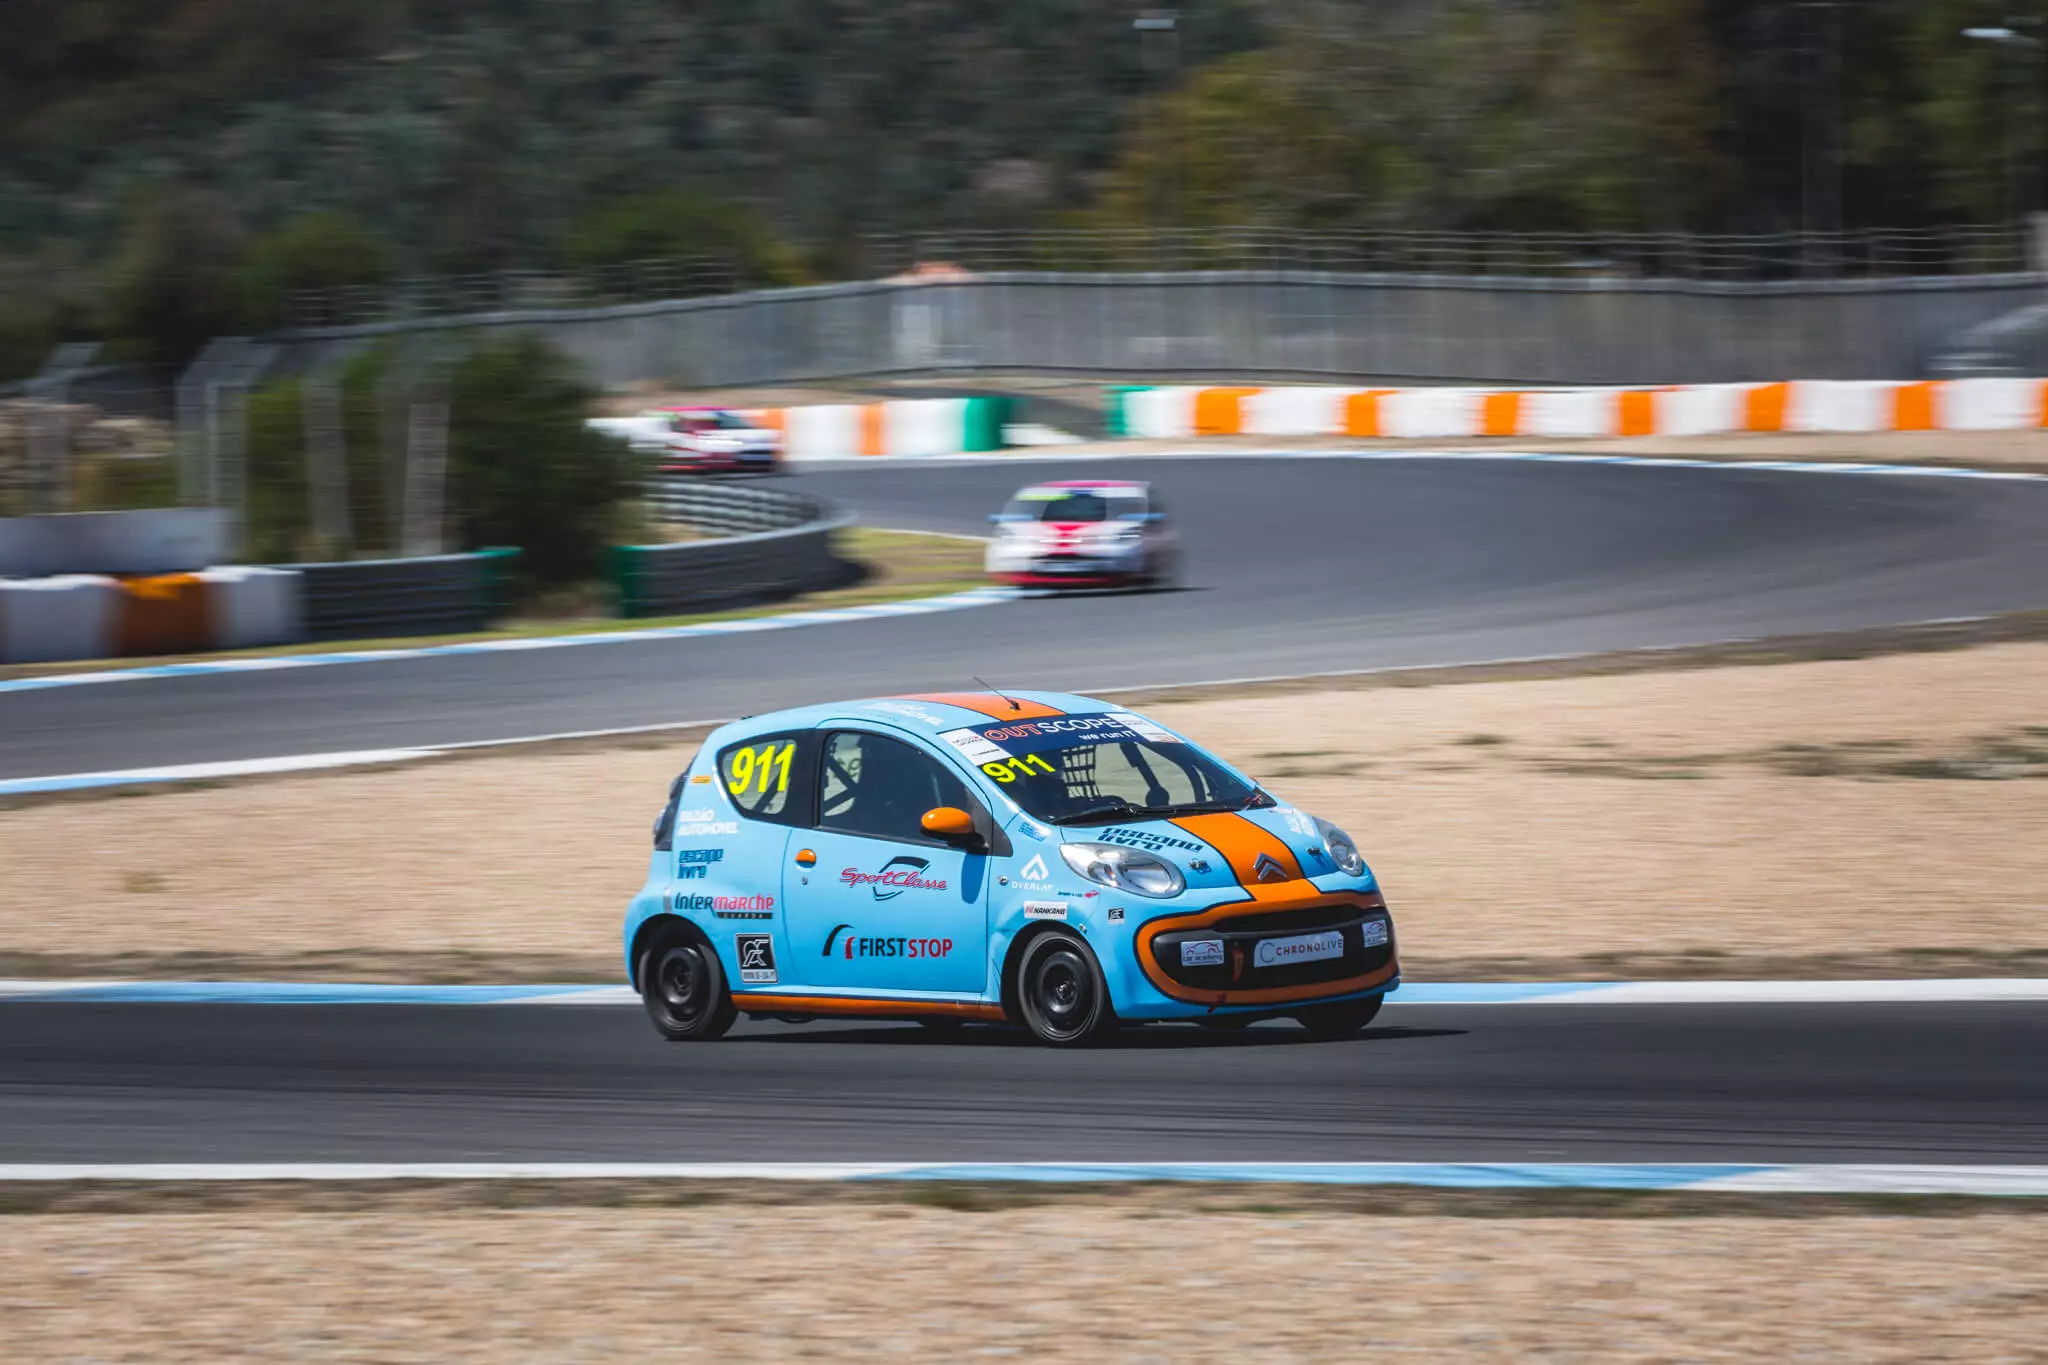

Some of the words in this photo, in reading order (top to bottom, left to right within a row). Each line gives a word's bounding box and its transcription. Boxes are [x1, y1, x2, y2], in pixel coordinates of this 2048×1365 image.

[984, 718, 1124, 741] OUTSCOPE
[729, 743, 795, 796] 911
[982, 753, 1056, 783] 911
[679, 849, 724, 863] escape
[1275, 939, 1343, 956] CHRONOLIVE
